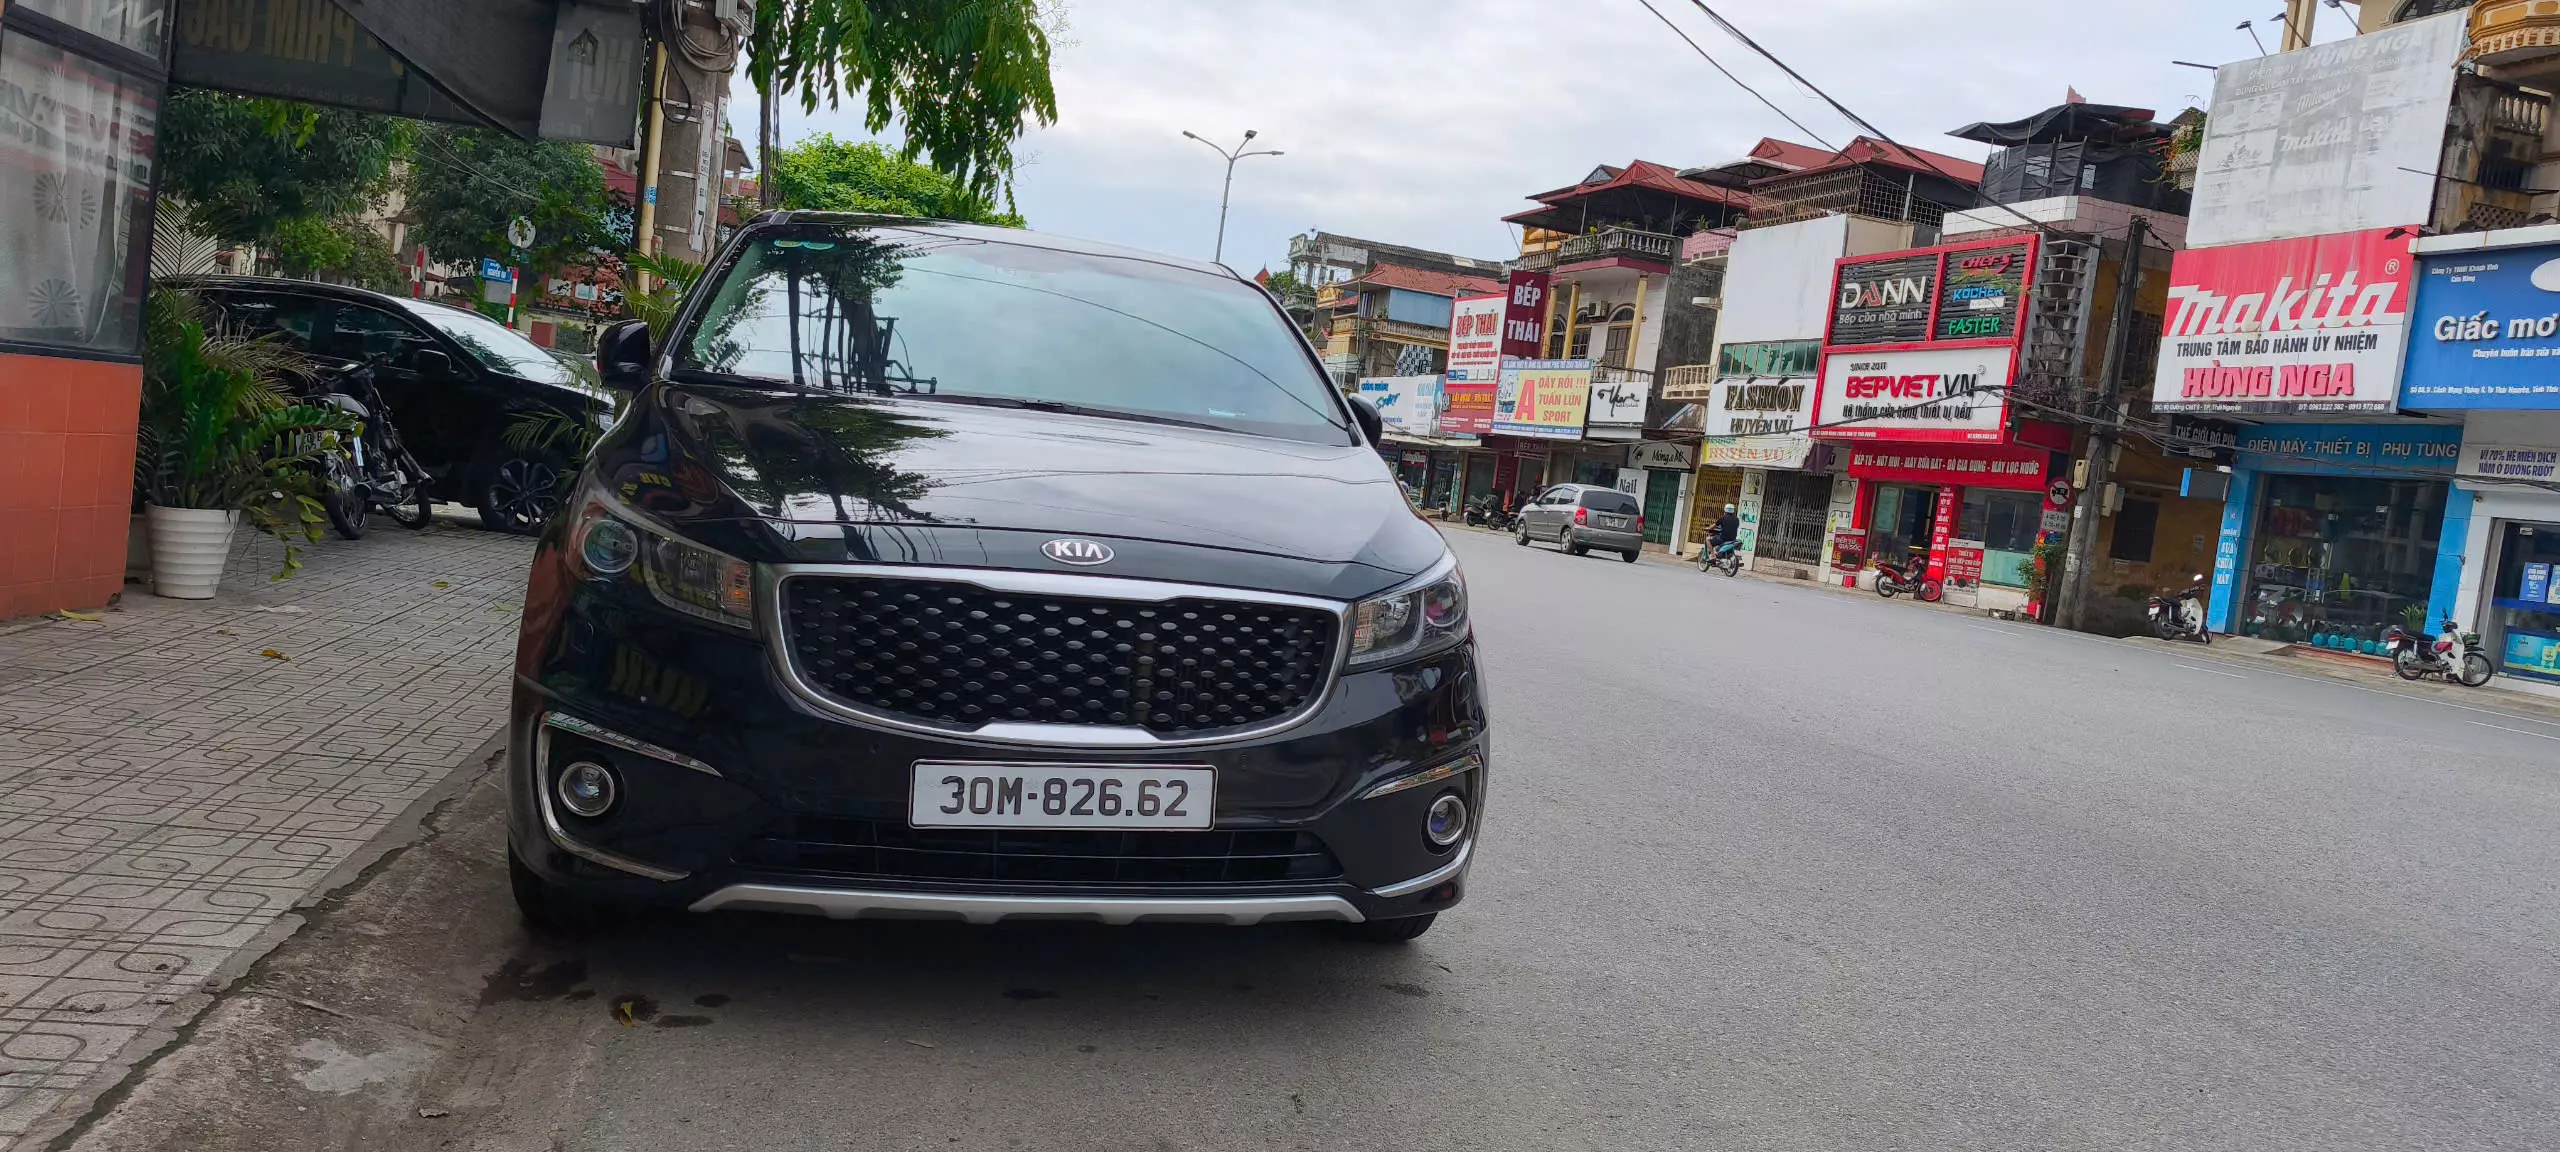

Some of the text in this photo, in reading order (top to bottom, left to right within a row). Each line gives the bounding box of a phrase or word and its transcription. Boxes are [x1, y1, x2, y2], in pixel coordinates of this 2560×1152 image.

[1513, 280, 1541, 307] BẾP
[1456, 307, 1498, 337] BẾP THÁI
[1507, 318, 1540, 343] THÁI
[1948, 317, 2000, 335] FASTER
[2434, 310, 2560, 341] Giấc mơ
[2176, 330, 2379, 357] TRUNG TÂM BẢO HÀNH ỦY NHIỆM
[1850, 362, 1870, 372] SINCE
[2180, 359, 2355, 398] HÙNG NGA
[1515, 380, 1535, 420] A
[1539, 391, 1562, 406] TUẤN
[1724, 383, 1806, 412] FASHION
[1543, 410, 1572, 422] SPORT
[2357, 440, 2371, 458] BỊ
[2382, 442, 2411, 459] PHỤ
[2416, 438, 2458, 457] TÙNG
[2489, 449, 2505, 461] 70%
[2537, 451, 2557, 464] DỊCH
[1853, 452, 1865, 465] BẾP
[1904, 455, 1917, 469] MÁY
[1991, 458, 2006, 473] MÁY
[2006, 460, 2019, 475] LỌC
[1618, 478, 1637, 494] Nail
[1054, 541, 1105, 559] KIA
[939, 775, 1189, 818] 30M-826.62
